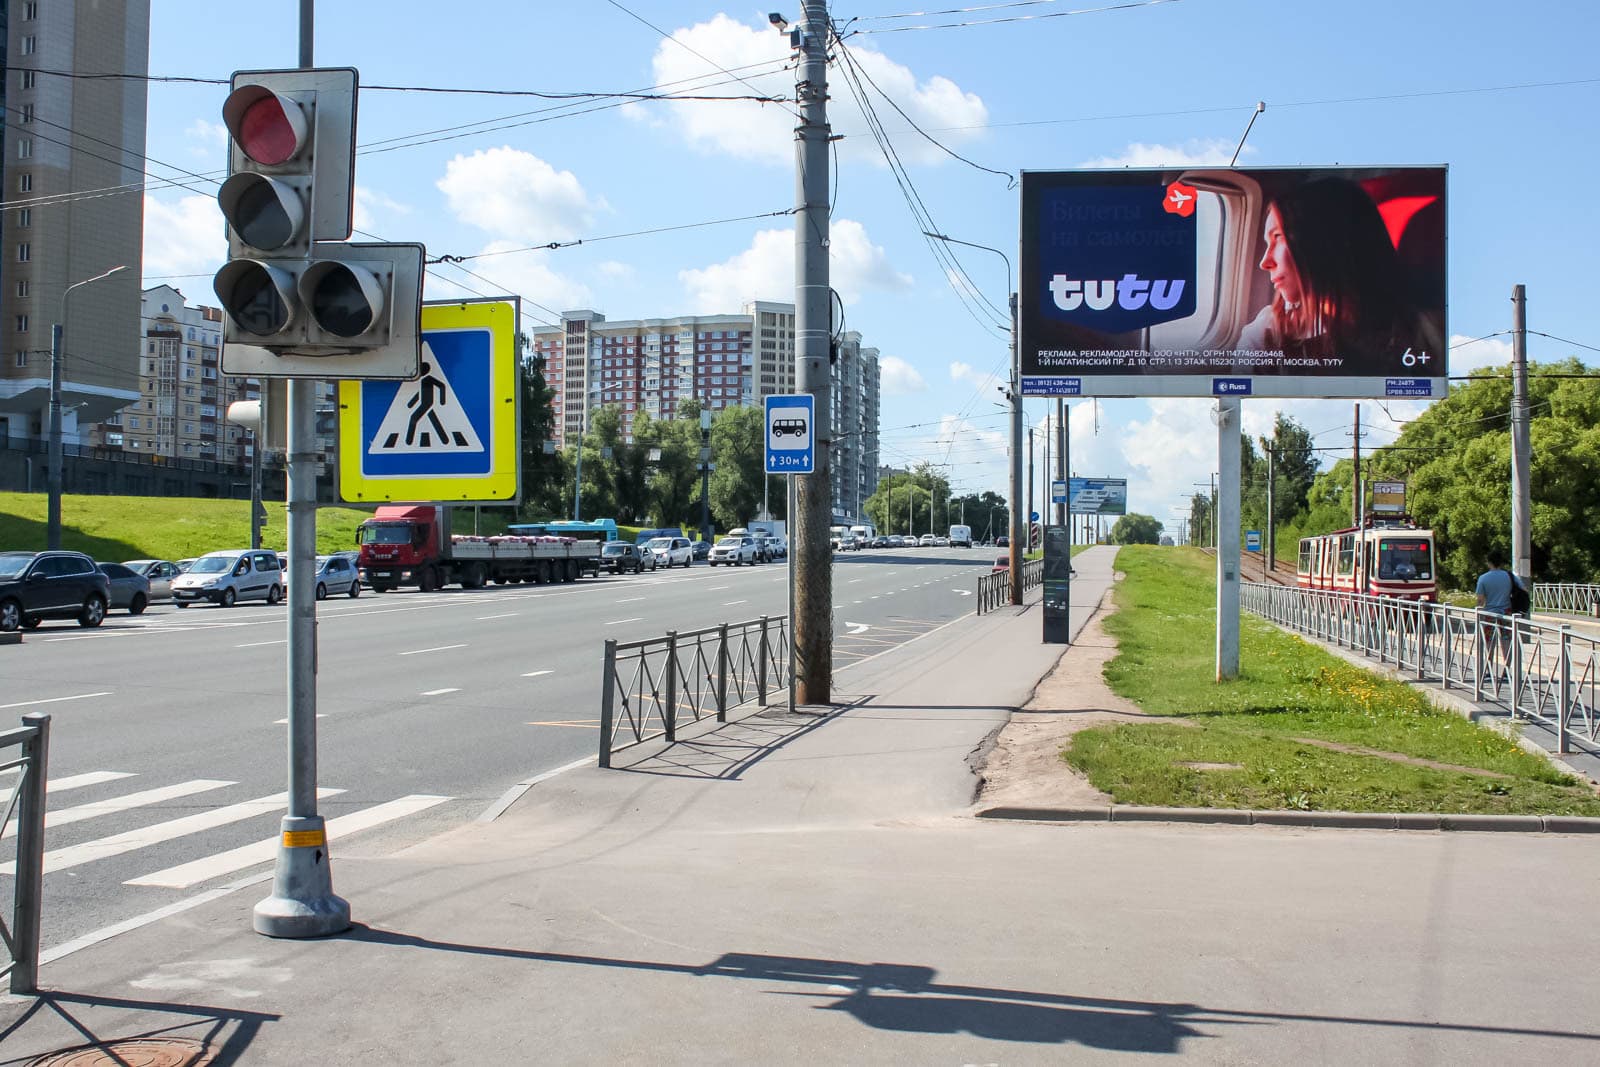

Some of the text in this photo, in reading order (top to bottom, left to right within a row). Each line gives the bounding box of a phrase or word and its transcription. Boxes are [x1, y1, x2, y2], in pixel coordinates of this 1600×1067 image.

[1049, 274, 1185, 311] tutu
[1154, 350, 1172, 358] ООО
[1203, 350, 1224, 358] ОГРН
[1402, 347, 1431, 366] 6+
[1052, 357, 1111, 366] НАГАТИНСКИЙ
[1174, 358, 1182, 366] 13
[1229, 383, 1247, 391] Russ
